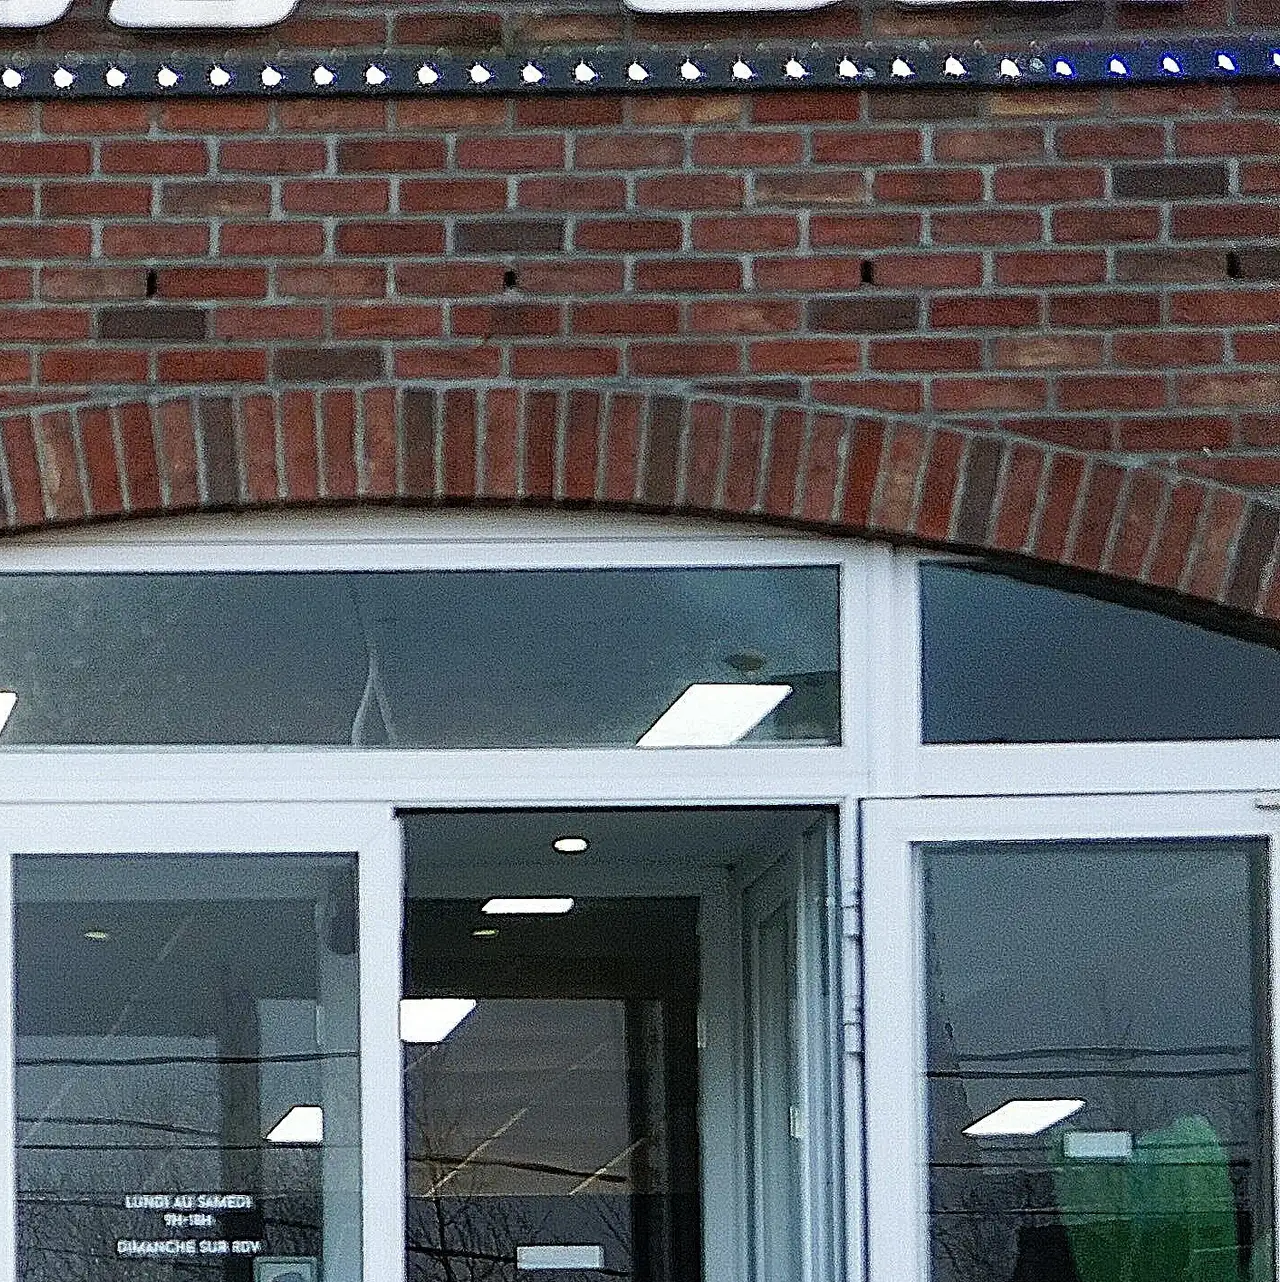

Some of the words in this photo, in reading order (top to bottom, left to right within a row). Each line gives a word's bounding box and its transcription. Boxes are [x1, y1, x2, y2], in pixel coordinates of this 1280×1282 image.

[125, 1194, 169, 1209] LUNDI
[173, 1194, 192, 1209] AU
[197, 1194, 253, 1209] SAMEDI
[117, 1240, 196, 1254] DIMANCHE
[199, 1240, 229, 1254] SUR
[231, 1240, 261, 1254] RDV
